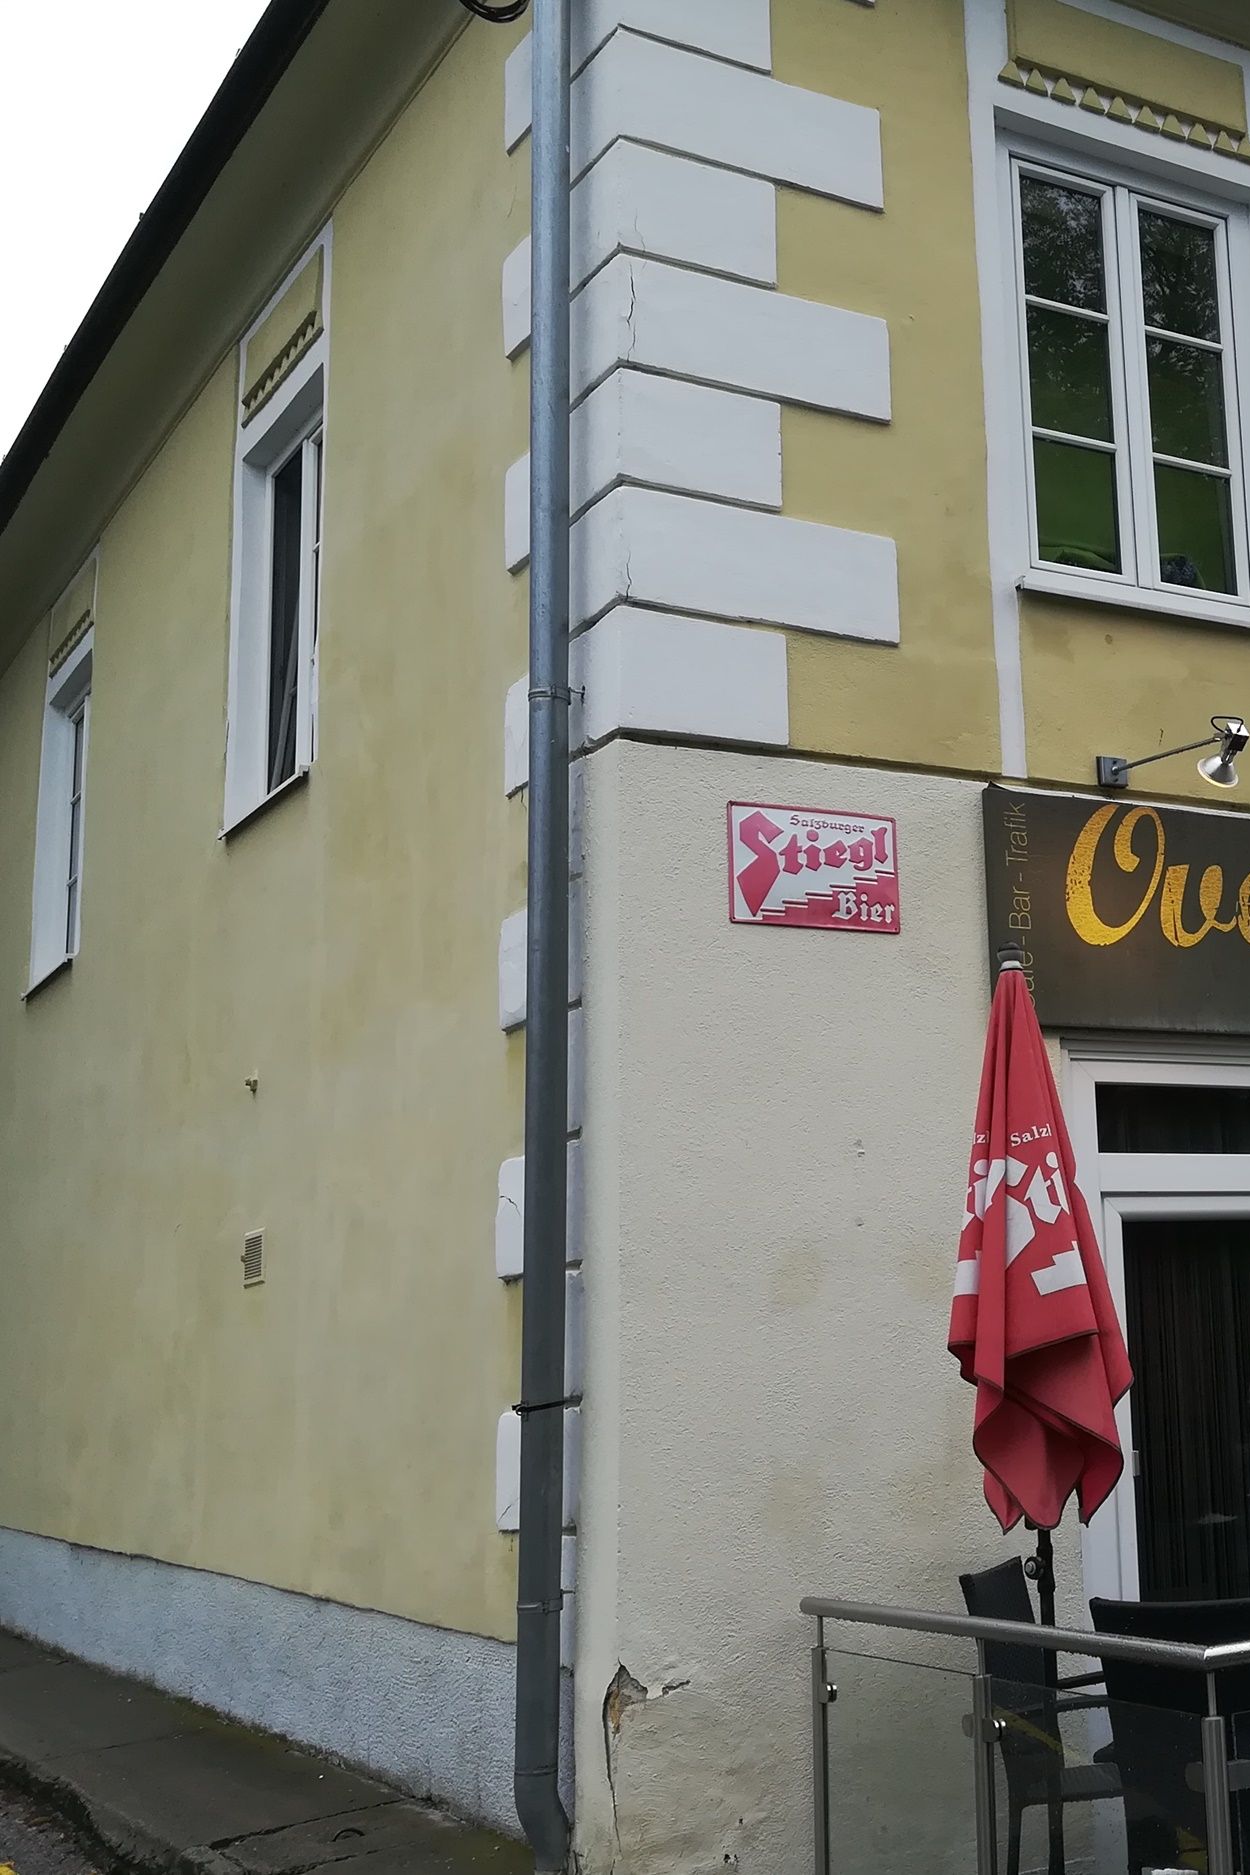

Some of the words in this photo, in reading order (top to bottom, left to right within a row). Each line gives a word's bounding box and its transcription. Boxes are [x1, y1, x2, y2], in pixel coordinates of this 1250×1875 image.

[789, 814, 865, 834] Salzburger
[1004, 802, 1028, 866] Trafik
[736, 810, 889, 917] Stiegl
[831, 891, 896, 924] Bier
[1009, 886, 1032, 930] Bar
